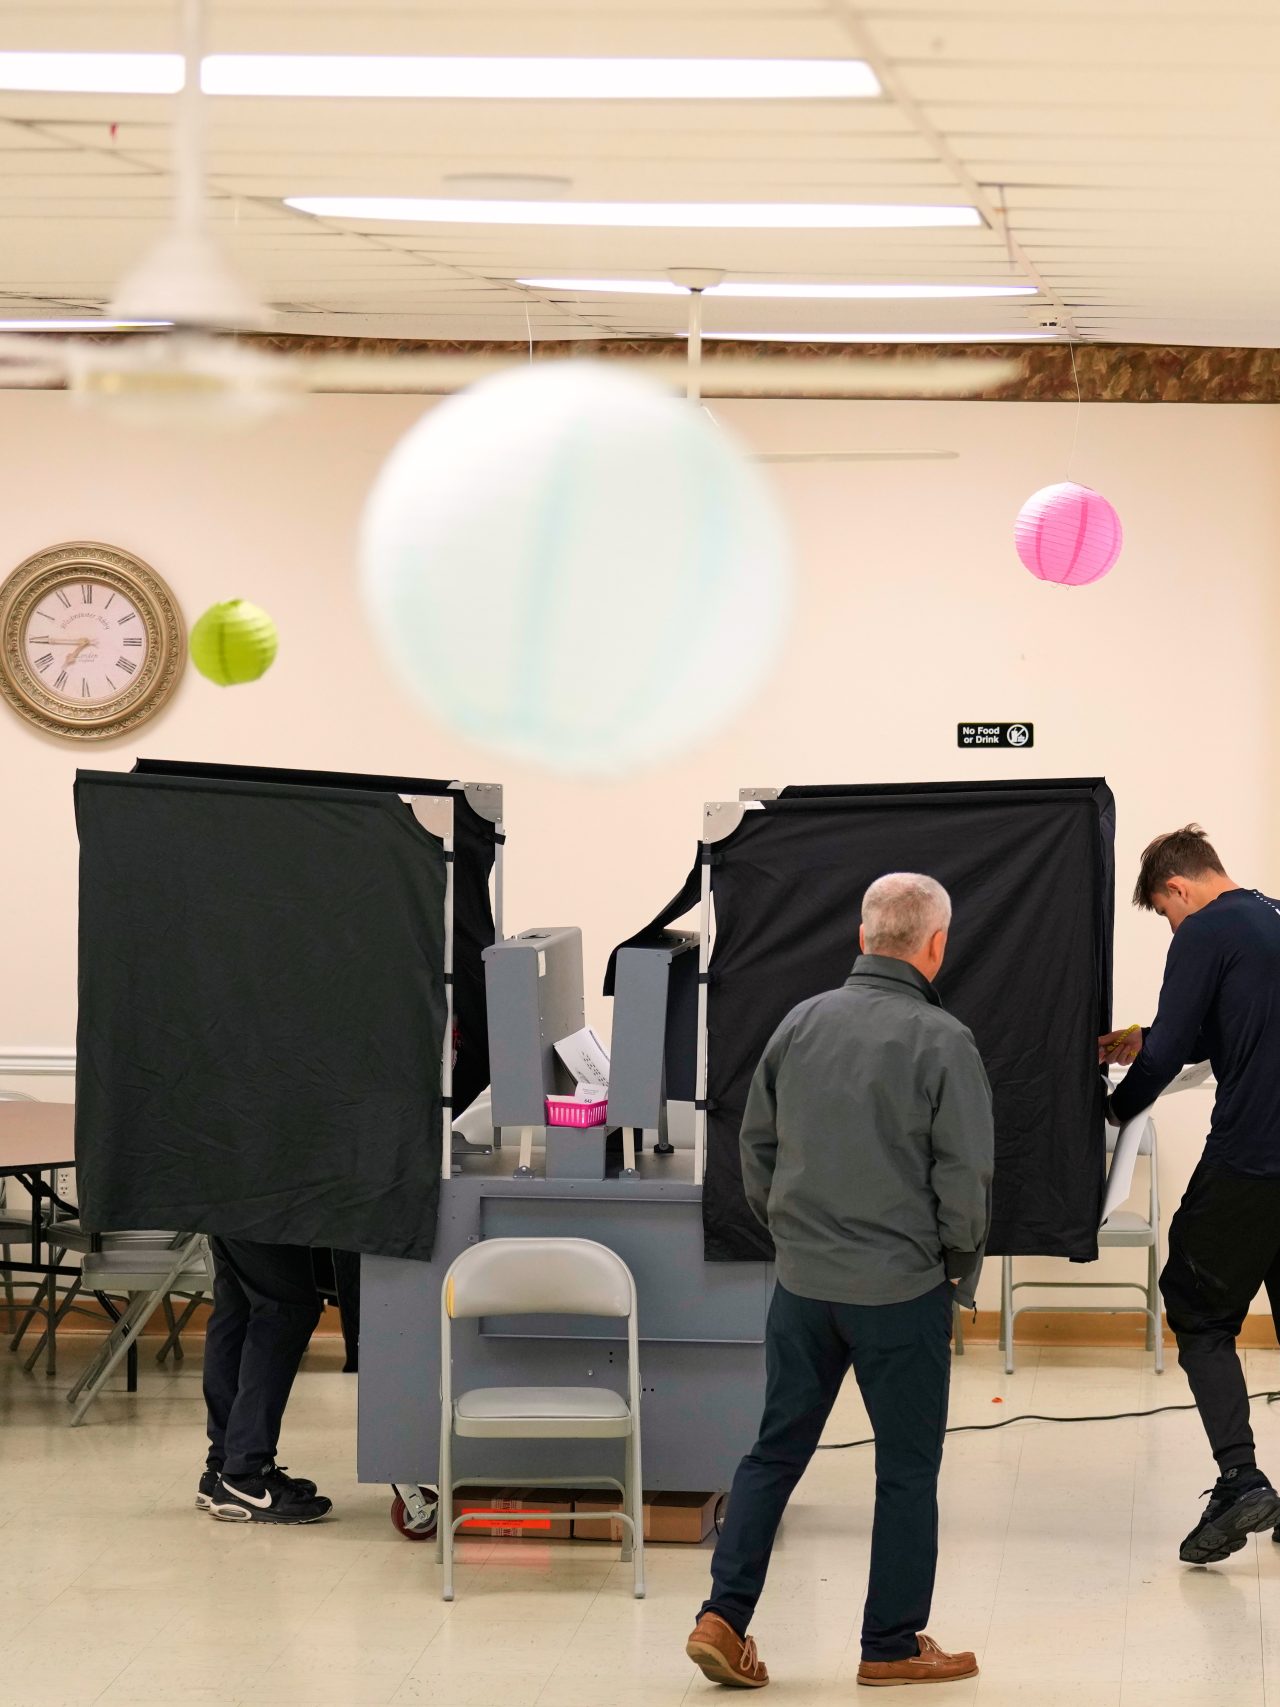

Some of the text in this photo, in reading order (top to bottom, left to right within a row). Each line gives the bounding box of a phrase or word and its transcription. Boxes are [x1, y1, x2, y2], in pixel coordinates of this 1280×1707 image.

[962, 726, 1001, 735] No Food
[963, 735, 1000, 744] or Drink
